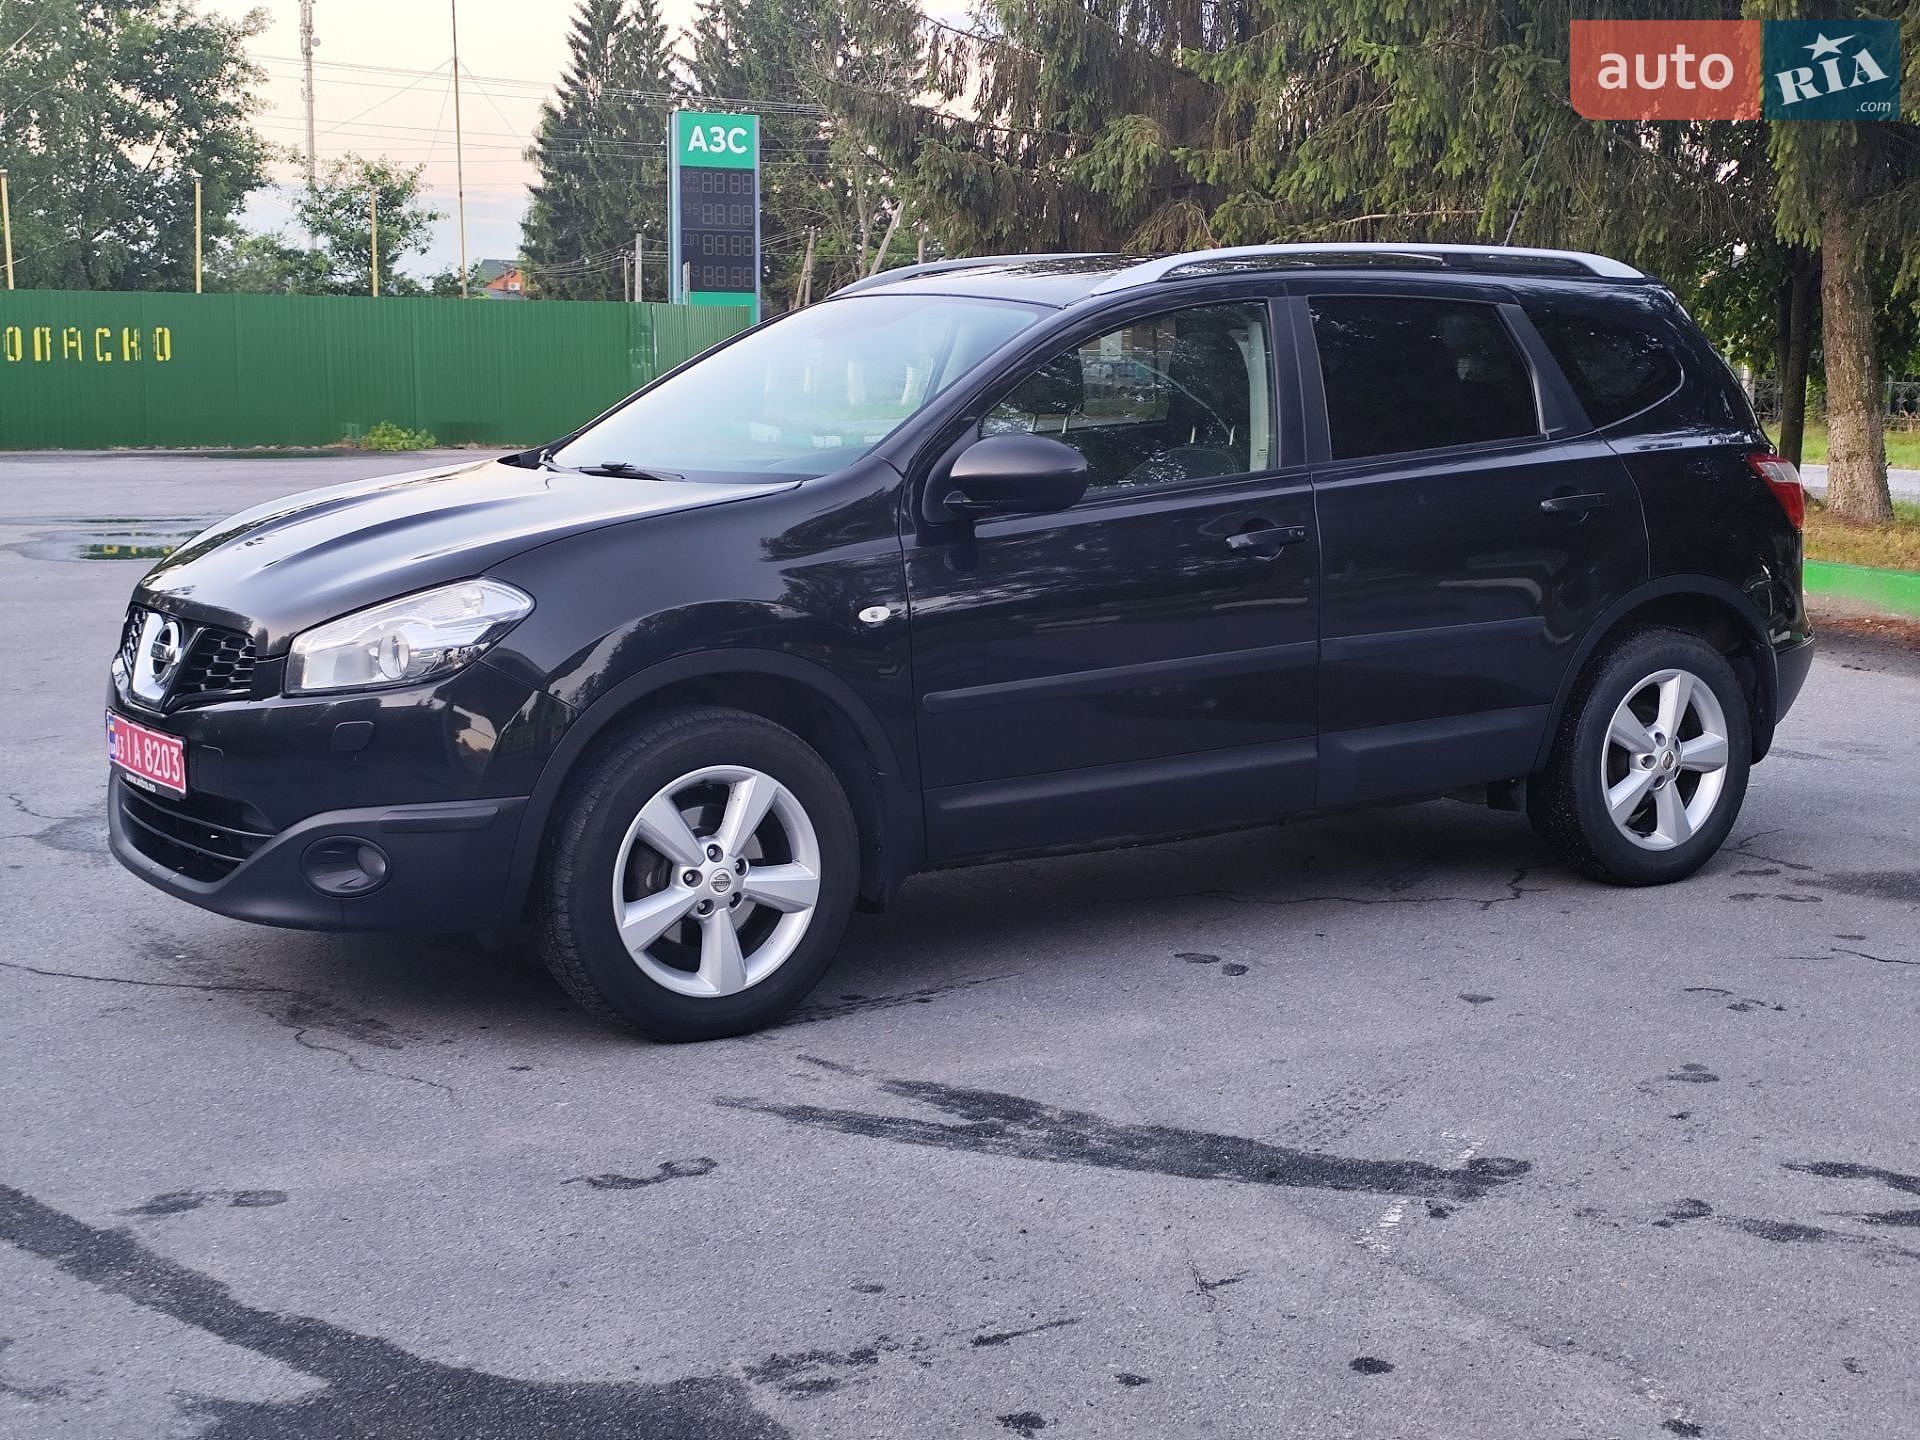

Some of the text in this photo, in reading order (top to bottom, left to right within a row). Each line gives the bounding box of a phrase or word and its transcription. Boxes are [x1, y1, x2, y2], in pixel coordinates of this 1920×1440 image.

[687, 125, 748, 154] АЗС
[3, 326, 172, 362] ОПАСНО
[144, 737, 180, 782] 8203
